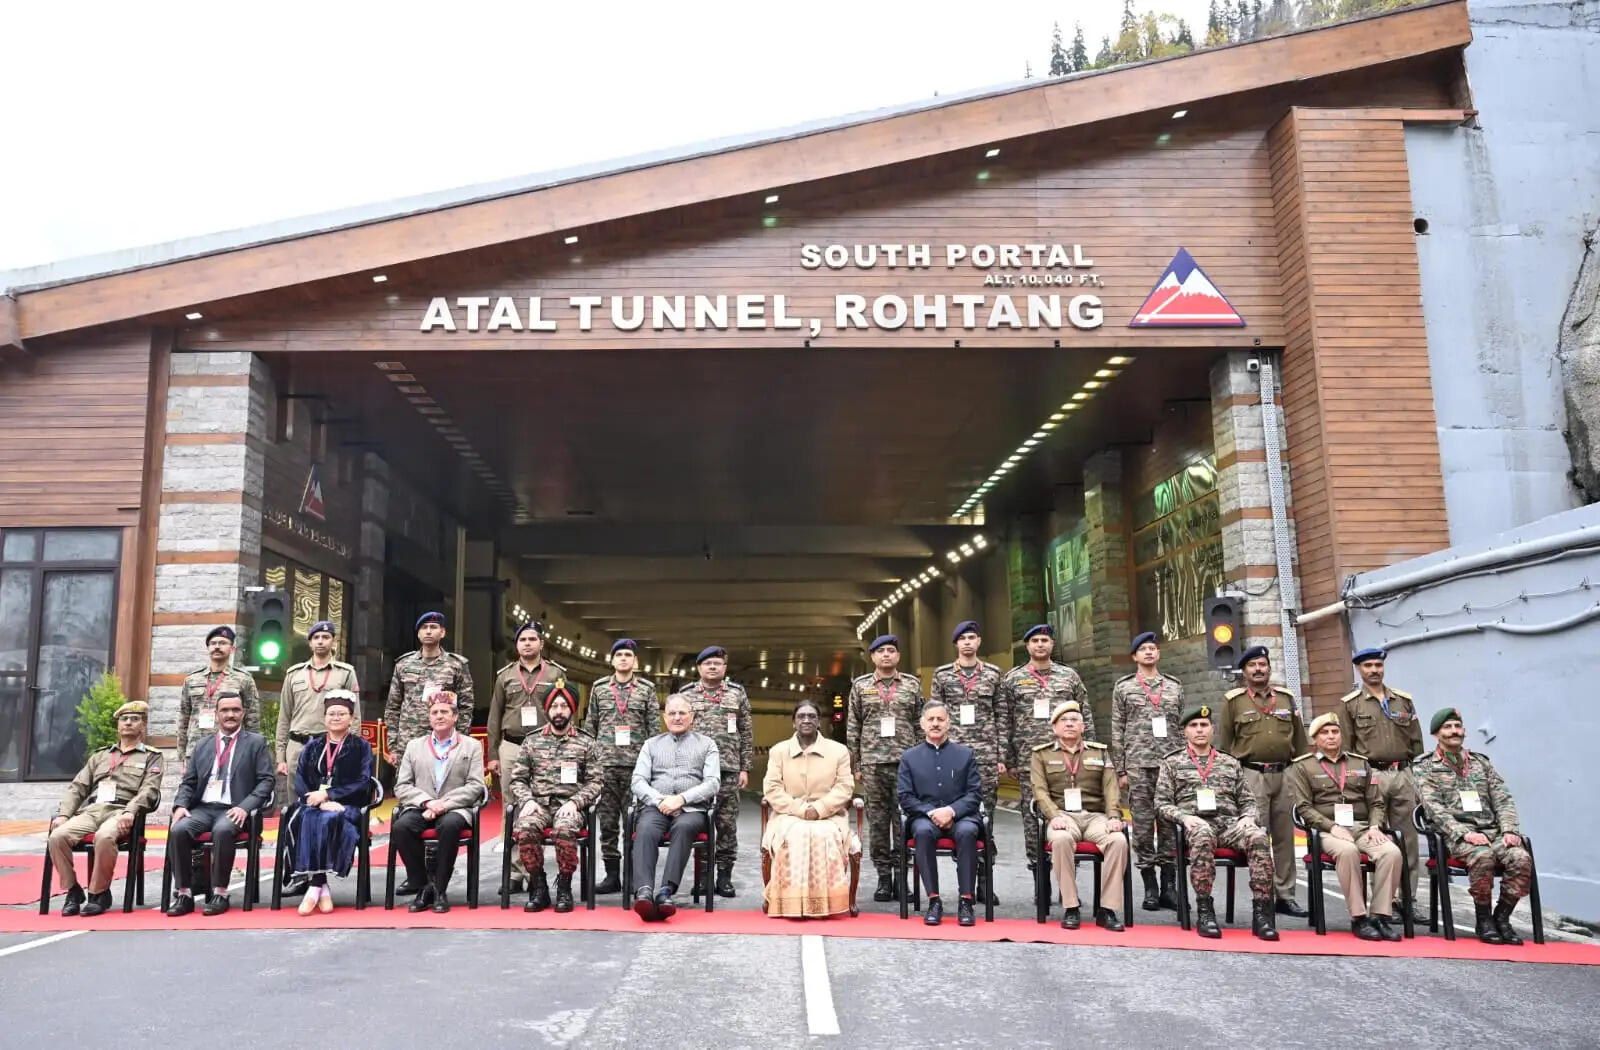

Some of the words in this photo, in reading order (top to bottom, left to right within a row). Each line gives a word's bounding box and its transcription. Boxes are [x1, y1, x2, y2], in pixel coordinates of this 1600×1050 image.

[800, 243, 931, 268] SOUTH
[946, 243, 1094, 268] PORTAL
[984, 273, 1015, 286] ALT.
[420, 296, 557, 332] ATAL
[570, 294, 821, 337] TUNNEL,
[834, 293, 1104, 329] ROHTANG
